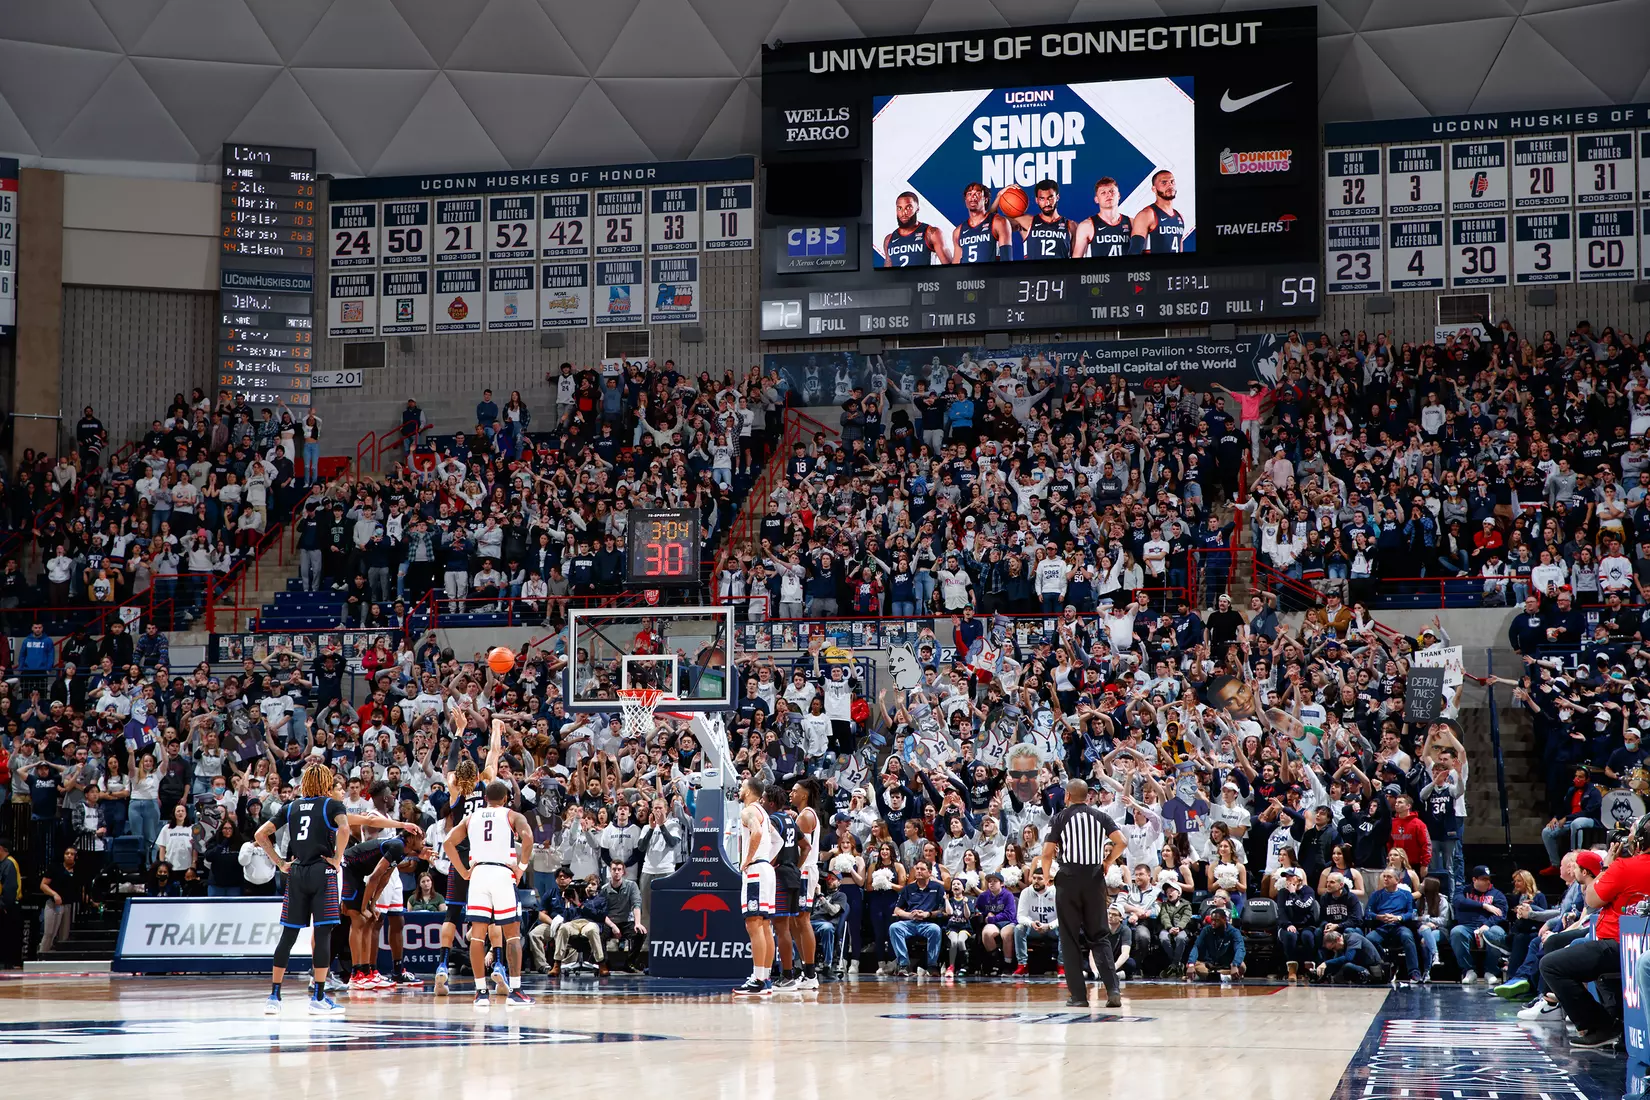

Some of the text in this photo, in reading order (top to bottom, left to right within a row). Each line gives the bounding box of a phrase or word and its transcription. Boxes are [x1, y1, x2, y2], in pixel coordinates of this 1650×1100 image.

[809, 22, 1262, 74] UNIVERSITY OF CONNECTICUT
[1005, 90, 1054, 104] UCONN
[784, 107, 850, 123] WELLS
[1432, 109, 1634, 133] UCONN HUSKIES OF
[786, 125, 849, 142] FARGO
[973, 111, 1085, 151] SENIOR
[1240, 150, 1292, 163] DUNKIN'
[1516, 150, 1567, 165] MONTGOMERY
[1588, 147, 1621, 160] CHARLES
[982, 150, 1077, 189] NIGHT
[1240, 161, 1290, 173] DONUTS
[421, 168, 656, 190] UCONN HUSKIES OF HONOR
[1530, 167, 1554, 195] 20
[1594, 163, 1616, 191] 31
[1342, 178, 1365, 205] 32
[1410, 175, 1421, 201] 3
[444, 201, 475, 212] JENNIFER
[1392, 204, 1439, 213] 2000-2004
[1477, 201, 1504, 210] COACH
[443, 212, 476, 223] RIZZOTTI
[719, 211, 738, 237] 10
[548, 220, 583, 246] 42
[606, 217, 632, 243] 25
[664, 214, 684, 241] 33
[1159, 225, 1185, 236] UCONN
[1216, 221, 1284, 235] TRAVELERS
[1532, 228, 1553, 239] TUCK
[388, 228, 423, 254] 50
[444, 225, 473, 251] 21
[496, 223, 529, 248] 52
[787, 226, 842, 249] CBS
[959, 233, 991, 247] UCONN
[1031, 229, 1067, 240] UCONN
[1096, 234, 1130, 245] UCONN
[1394, 234, 1438, 247] JEFFERSON
[1460, 231, 1497, 244] STEWART
[336, 230, 371, 256] 24
[888, 243, 923, 256] UCONN
[1040, 239, 1056, 257] 12
[1171, 236, 1179, 254] 4
[968, 245, 978, 263] 5
[1534, 242, 1552, 271] 3
[1588, 239, 1624, 268] CD
[660, 260, 687, 270] NATIONAL
[796, 259, 815, 267] Xerox
[816, 257, 847, 268] Company
[1336, 252, 1371, 280] 23
[1407, 250, 1424, 276] 4
[1461, 246, 1496, 275] 30
[495, 267, 527, 278] NATIONAL
[549, 265, 580, 275] NATIONAL
[605, 262, 632, 273] NATIONAL
[338, 275, 367, 285] NATIONAL
[390, 272, 419, 283] NATIONAL
[444, 270, 473, 280] NATIONAL
[604, 273, 634, 285] CHAMPION
[659, 270, 689, 282] CHAMPION
[1081, 274, 1111, 285] BONUS
[1128, 271, 1151, 282] POSS
[441, 280, 475, 292] CHAMPION
[494, 278, 528, 290] CHAMPION
[548, 276, 582, 288] CHAMPION
[917, 282, 940, 292] POSS
[956, 279, 986, 290] BONUS
[335, 286, 369, 296] CHAMPION
[388, 283, 422, 295] CHAMPION
[1018, 279, 1064, 302] 3:04
[1281, 277, 1316, 306] 59
[1091, 304, 1144, 319] TM FLS 9
[1159, 301, 1209, 317] 30 SEC 0
[1226, 300, 1253, 313] FULL
[772, 301, 801, 327] 72
[938, 312, 976, 326] TM FLS
[821, 319, 846, 331] FULL
[872, 316, 909, 329] 30 SEC
[1048, 342, 1252, 363] Harry A. Gampel Pavilion Storrs, CT
[1122, 358, 1237, 374] Capital of the World
[312, 372, 361, 384] SEC 201
[796, 461, 807, 473] 18
[652, 521, 689, 540] 3:04
[645, 543, 683, 576] 30
[1074, 575, 1083, 583] 50
[1443, 647, 1456, 655] YOU
[1411, 677, 1439, 688] DEPAUL
[1412, 688, 1435, 699] TAKES
[1410, 699, 1432, 710] ALL 6
[934, 741, 947, 755] 12
[990, 745, 1002, 758] 12
[1045, 741, 1051, 753] 1
[847, 770, 861, 784] 12
[481, 811, 496, 819] COLE
[1184, 810, 1189, 820] I
[1433, 803, 1446, 814] 34
[296, 815, 311, 841] 3
[484, 820, 492, 842] 2
[1185, 820, 1196, 830] CT
[1039, 913, 1049, 924] 15
[144, 922, 280, 947] TRAVELER
[650, 940, 753, 959] TRAVELERS
